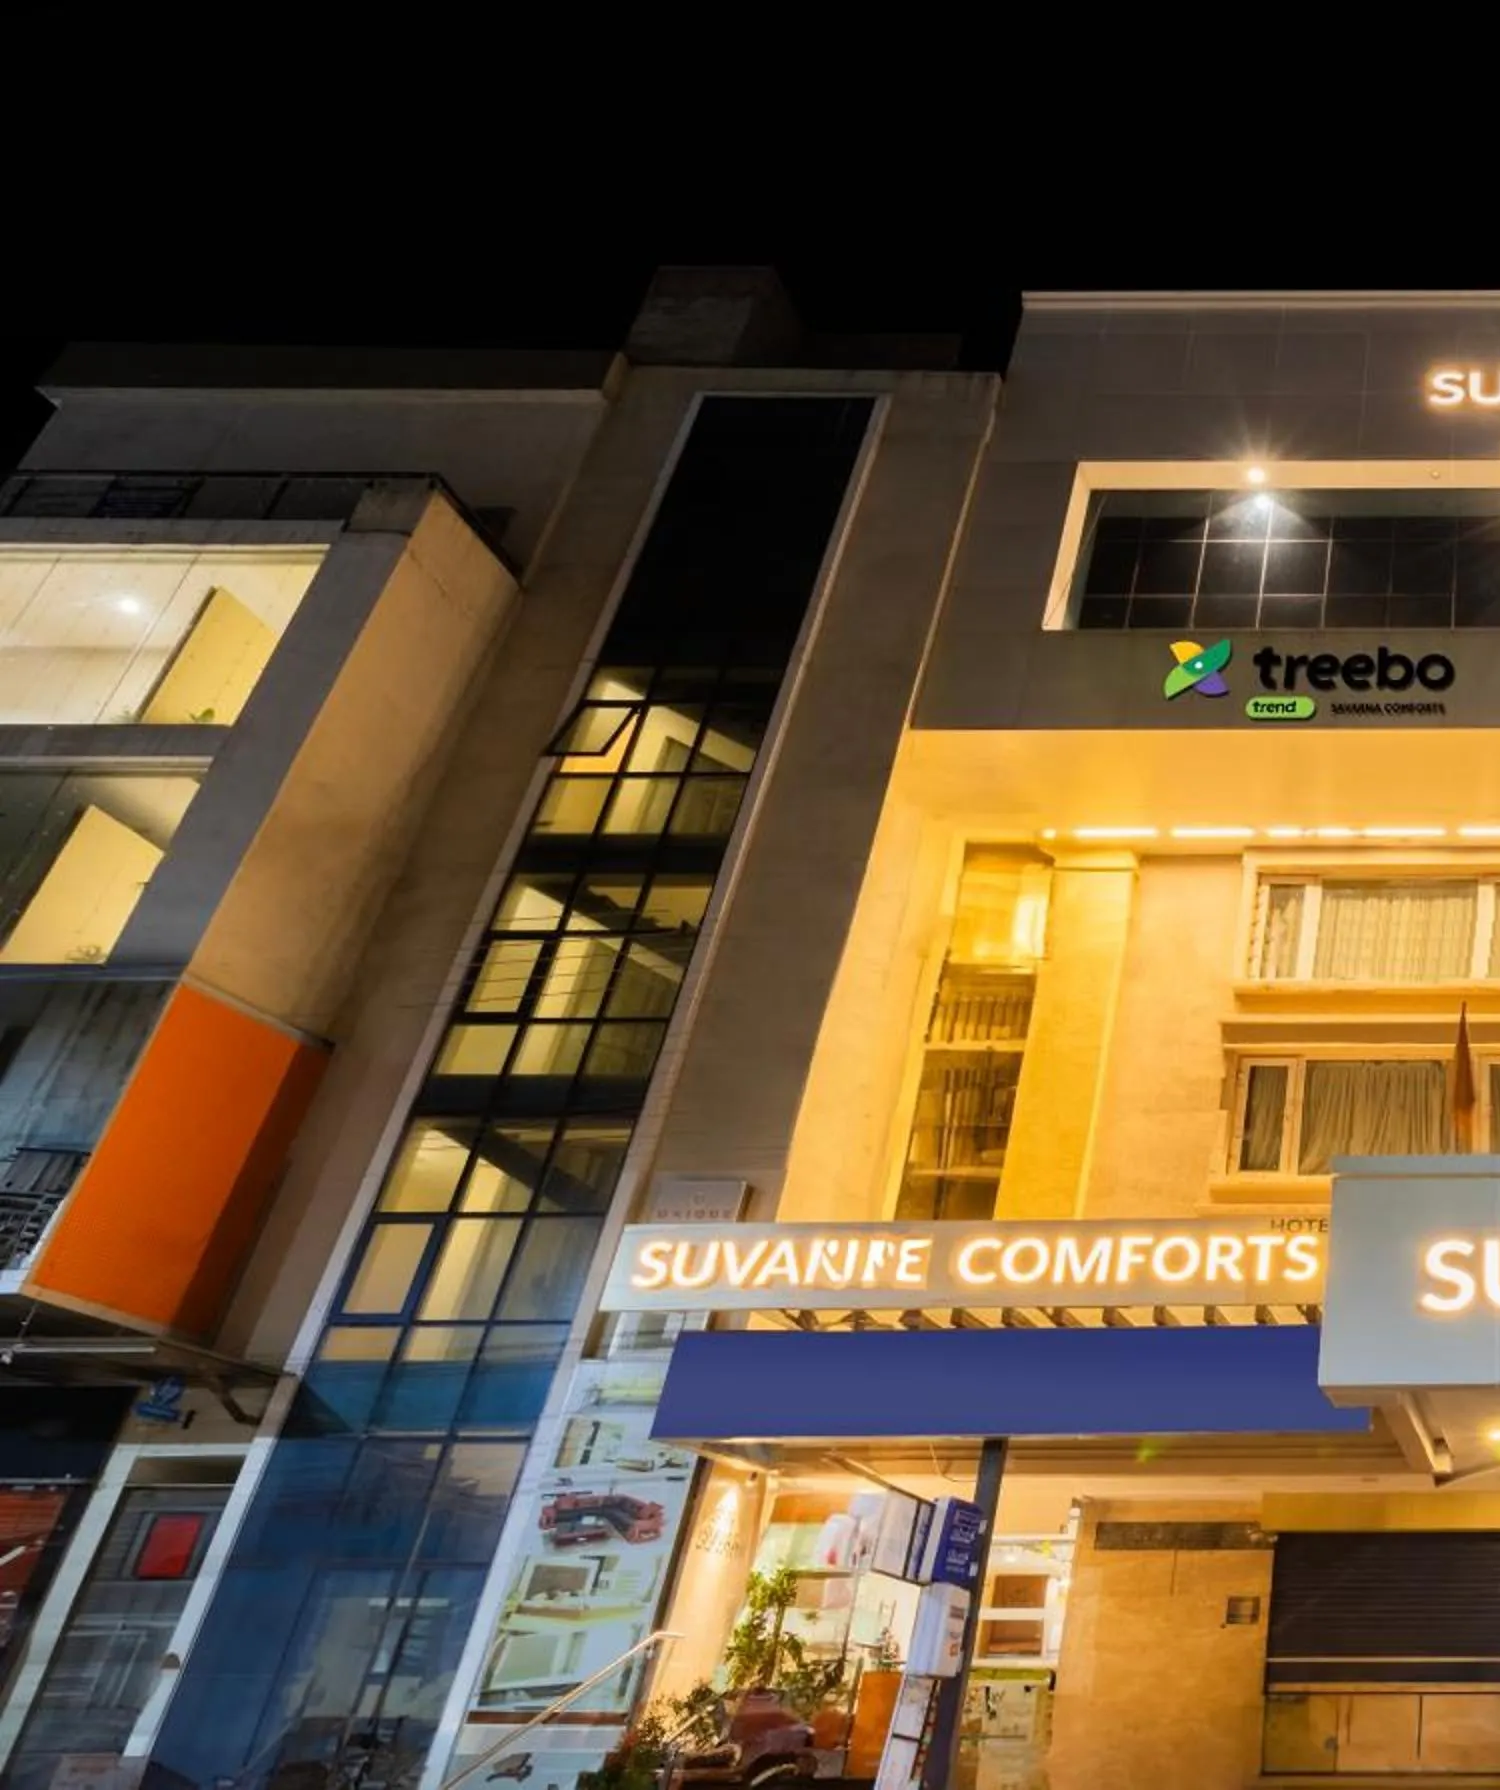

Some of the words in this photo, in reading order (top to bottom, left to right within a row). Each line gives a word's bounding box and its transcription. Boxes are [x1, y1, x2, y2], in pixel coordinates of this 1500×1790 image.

[1252, 646, 1456, 692] treebo
[1252, 701, 1297, 714] trend
[1270, 1218, 1329, 1233] HOTE
[957, 1234, 1320, 1284] COMFORTS
